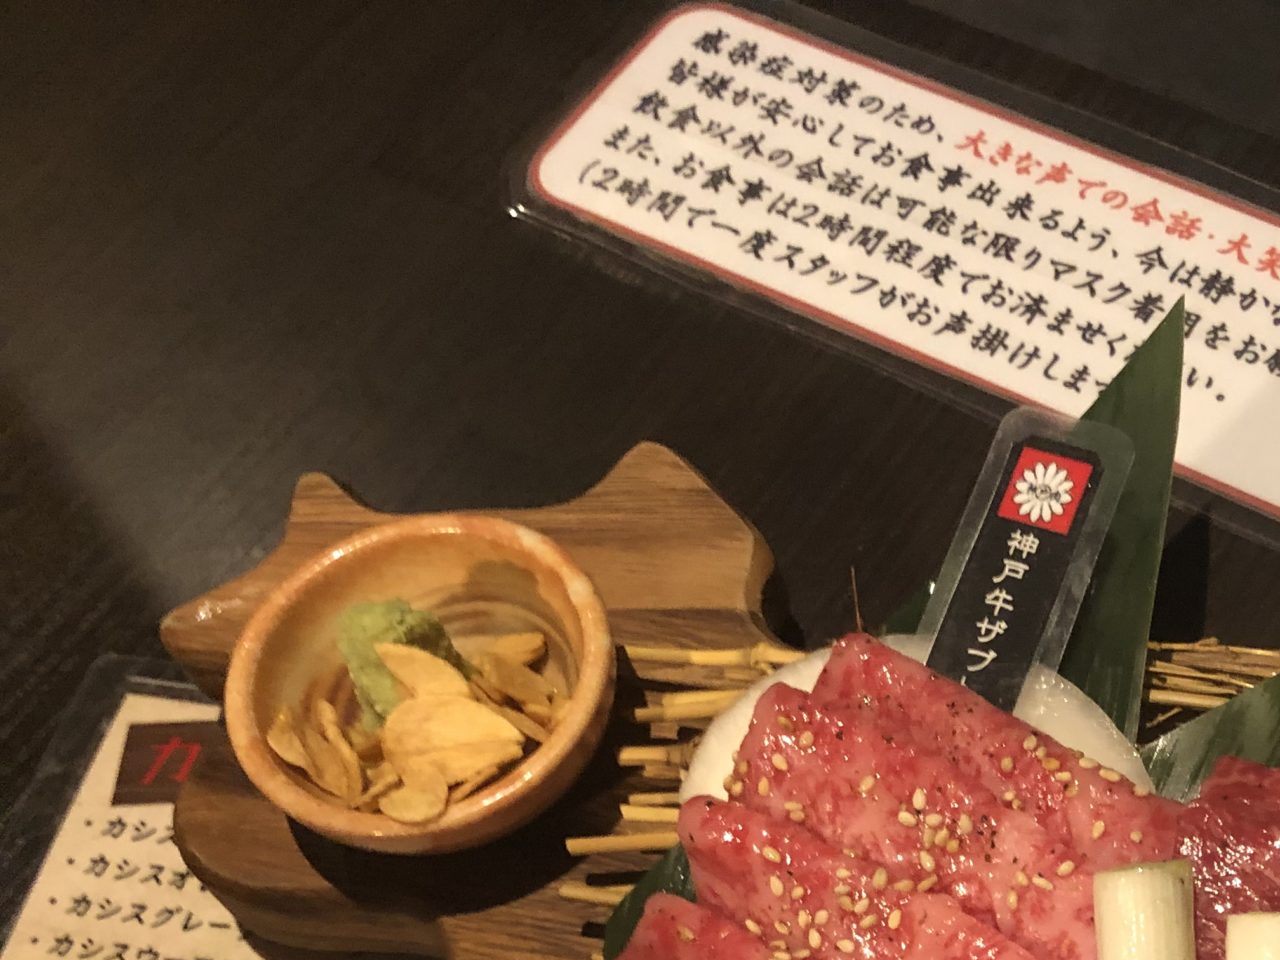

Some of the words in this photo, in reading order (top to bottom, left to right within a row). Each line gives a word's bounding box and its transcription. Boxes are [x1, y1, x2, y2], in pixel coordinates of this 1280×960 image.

[961, 529, 1040, 686] 神戸牛ザブ
